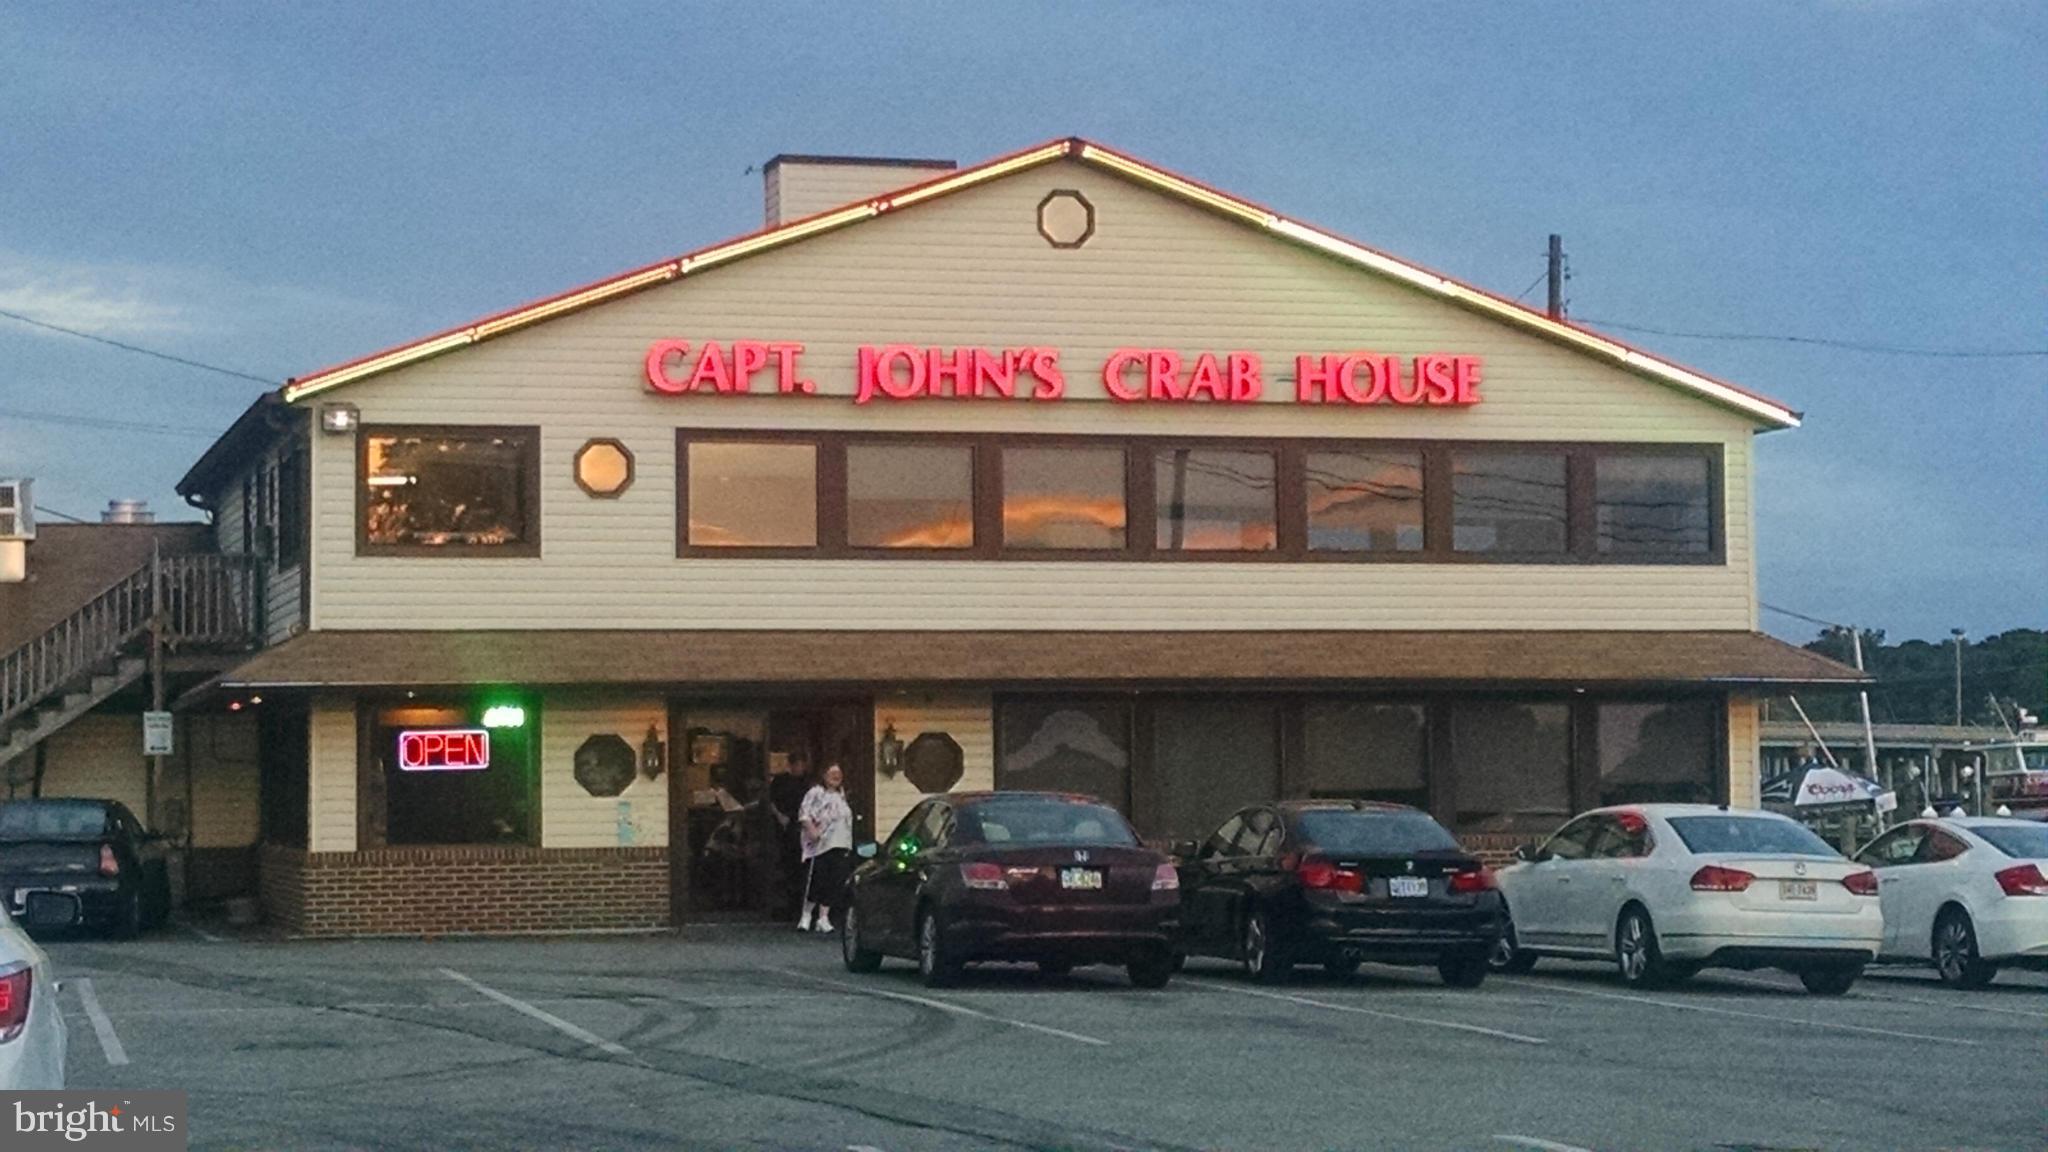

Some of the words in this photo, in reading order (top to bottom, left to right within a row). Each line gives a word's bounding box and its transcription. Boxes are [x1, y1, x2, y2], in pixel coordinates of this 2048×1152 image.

[646, 340, 816, 393] CAPT.
[855, 346, 1064, 404] JOHN'S
[1104, 351, 1262, 402] CRAB
[1295, 354, 1482, 406] HOUSE
[404, 734, 485, 766] OPEN
